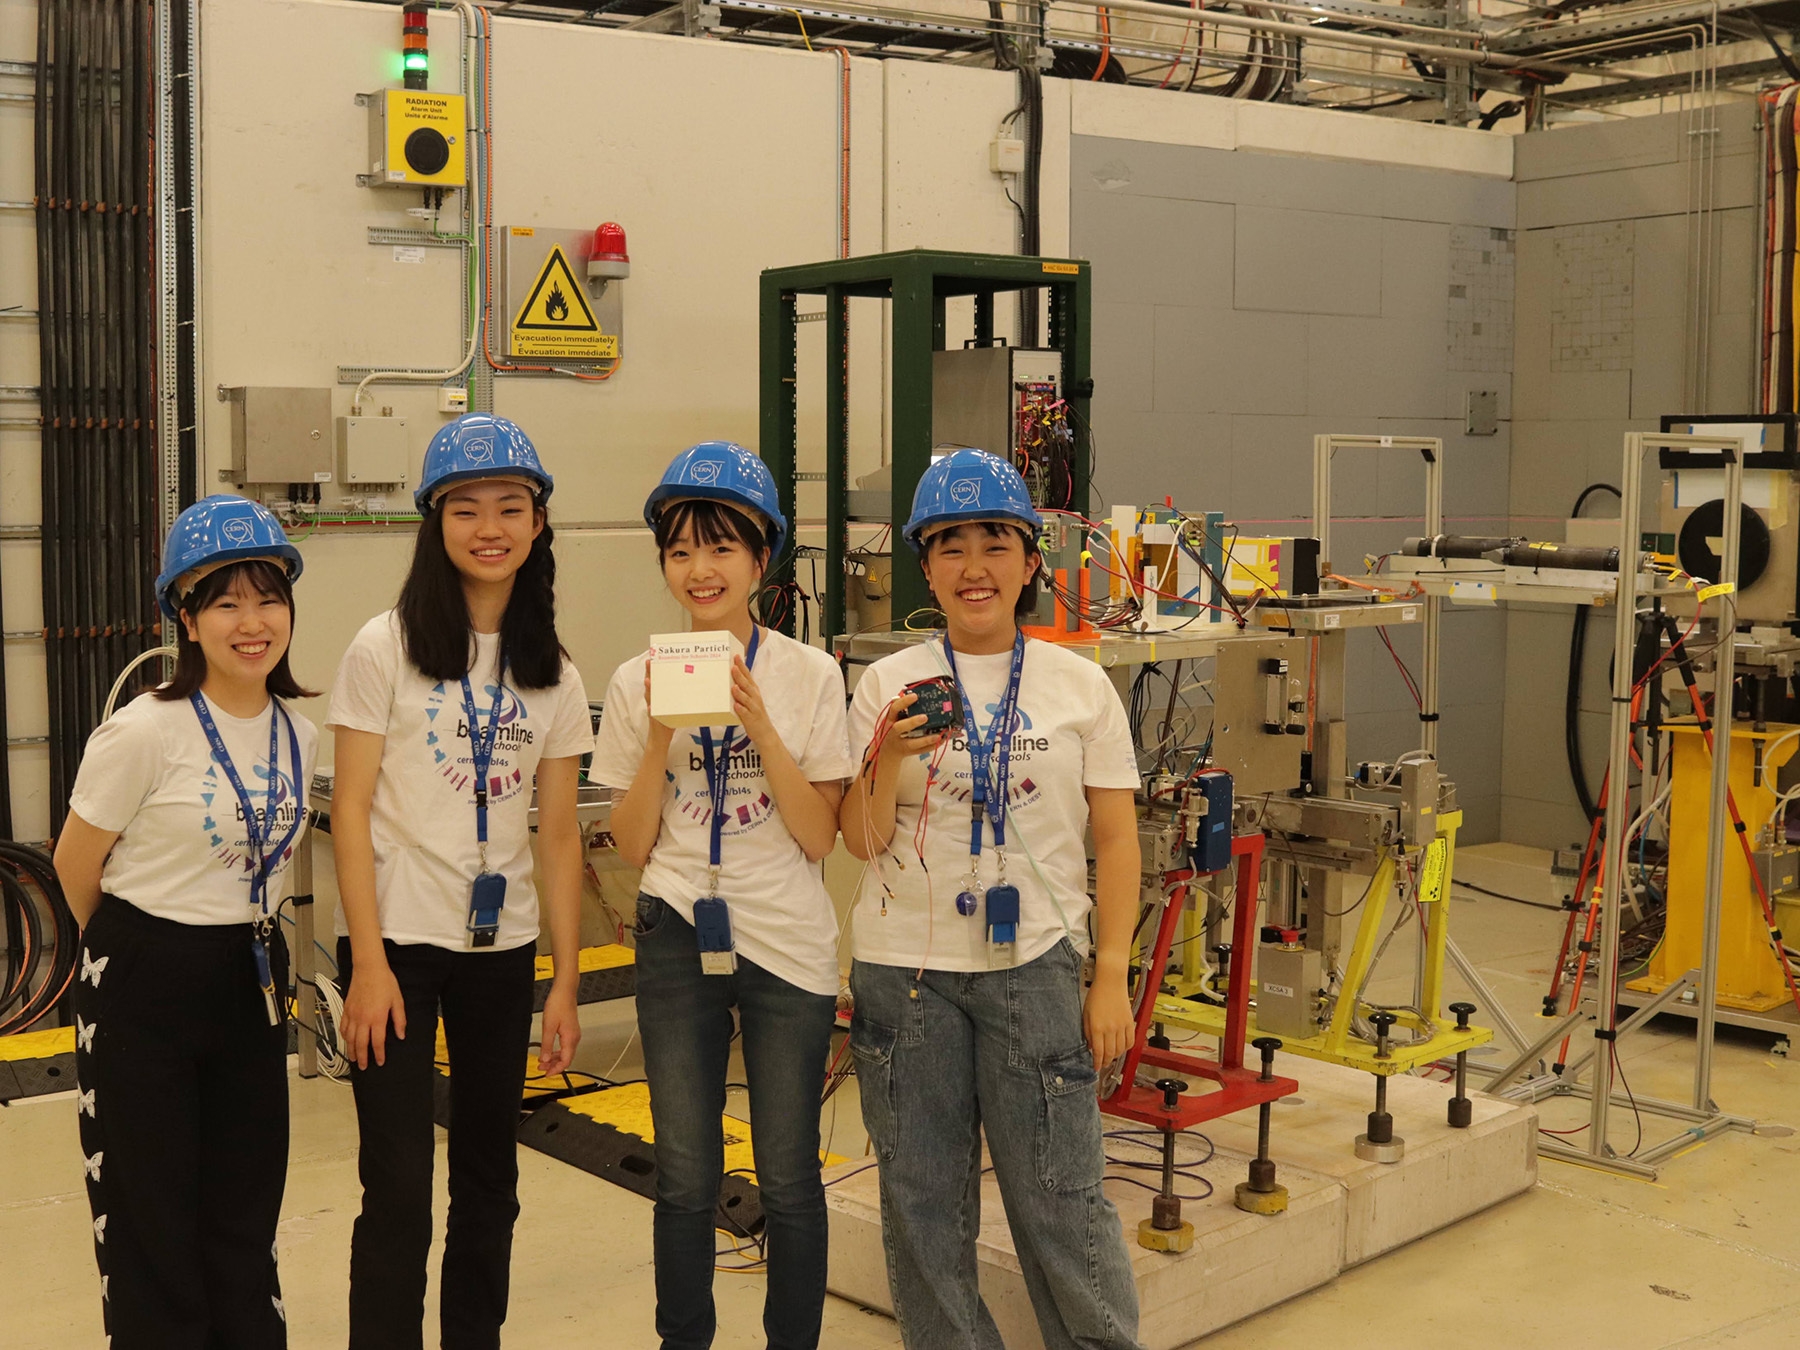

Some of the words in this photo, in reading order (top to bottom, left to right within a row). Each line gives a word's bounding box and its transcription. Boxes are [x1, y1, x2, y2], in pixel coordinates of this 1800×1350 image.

[406, 98, 447, 106] RADIATION
[514, 334, 562, 342] Evacuation
[694, 644, 730, 652] Particle
[196, 699, 208, 715] CERN
[214, 737, 225, 752] CERN
[233, 774, 243, 790] CERN
[497, 794, 512, 803] CERN
[1027, 791, 1042, 804] DESY
[747, 820, 763, 830] CERN
